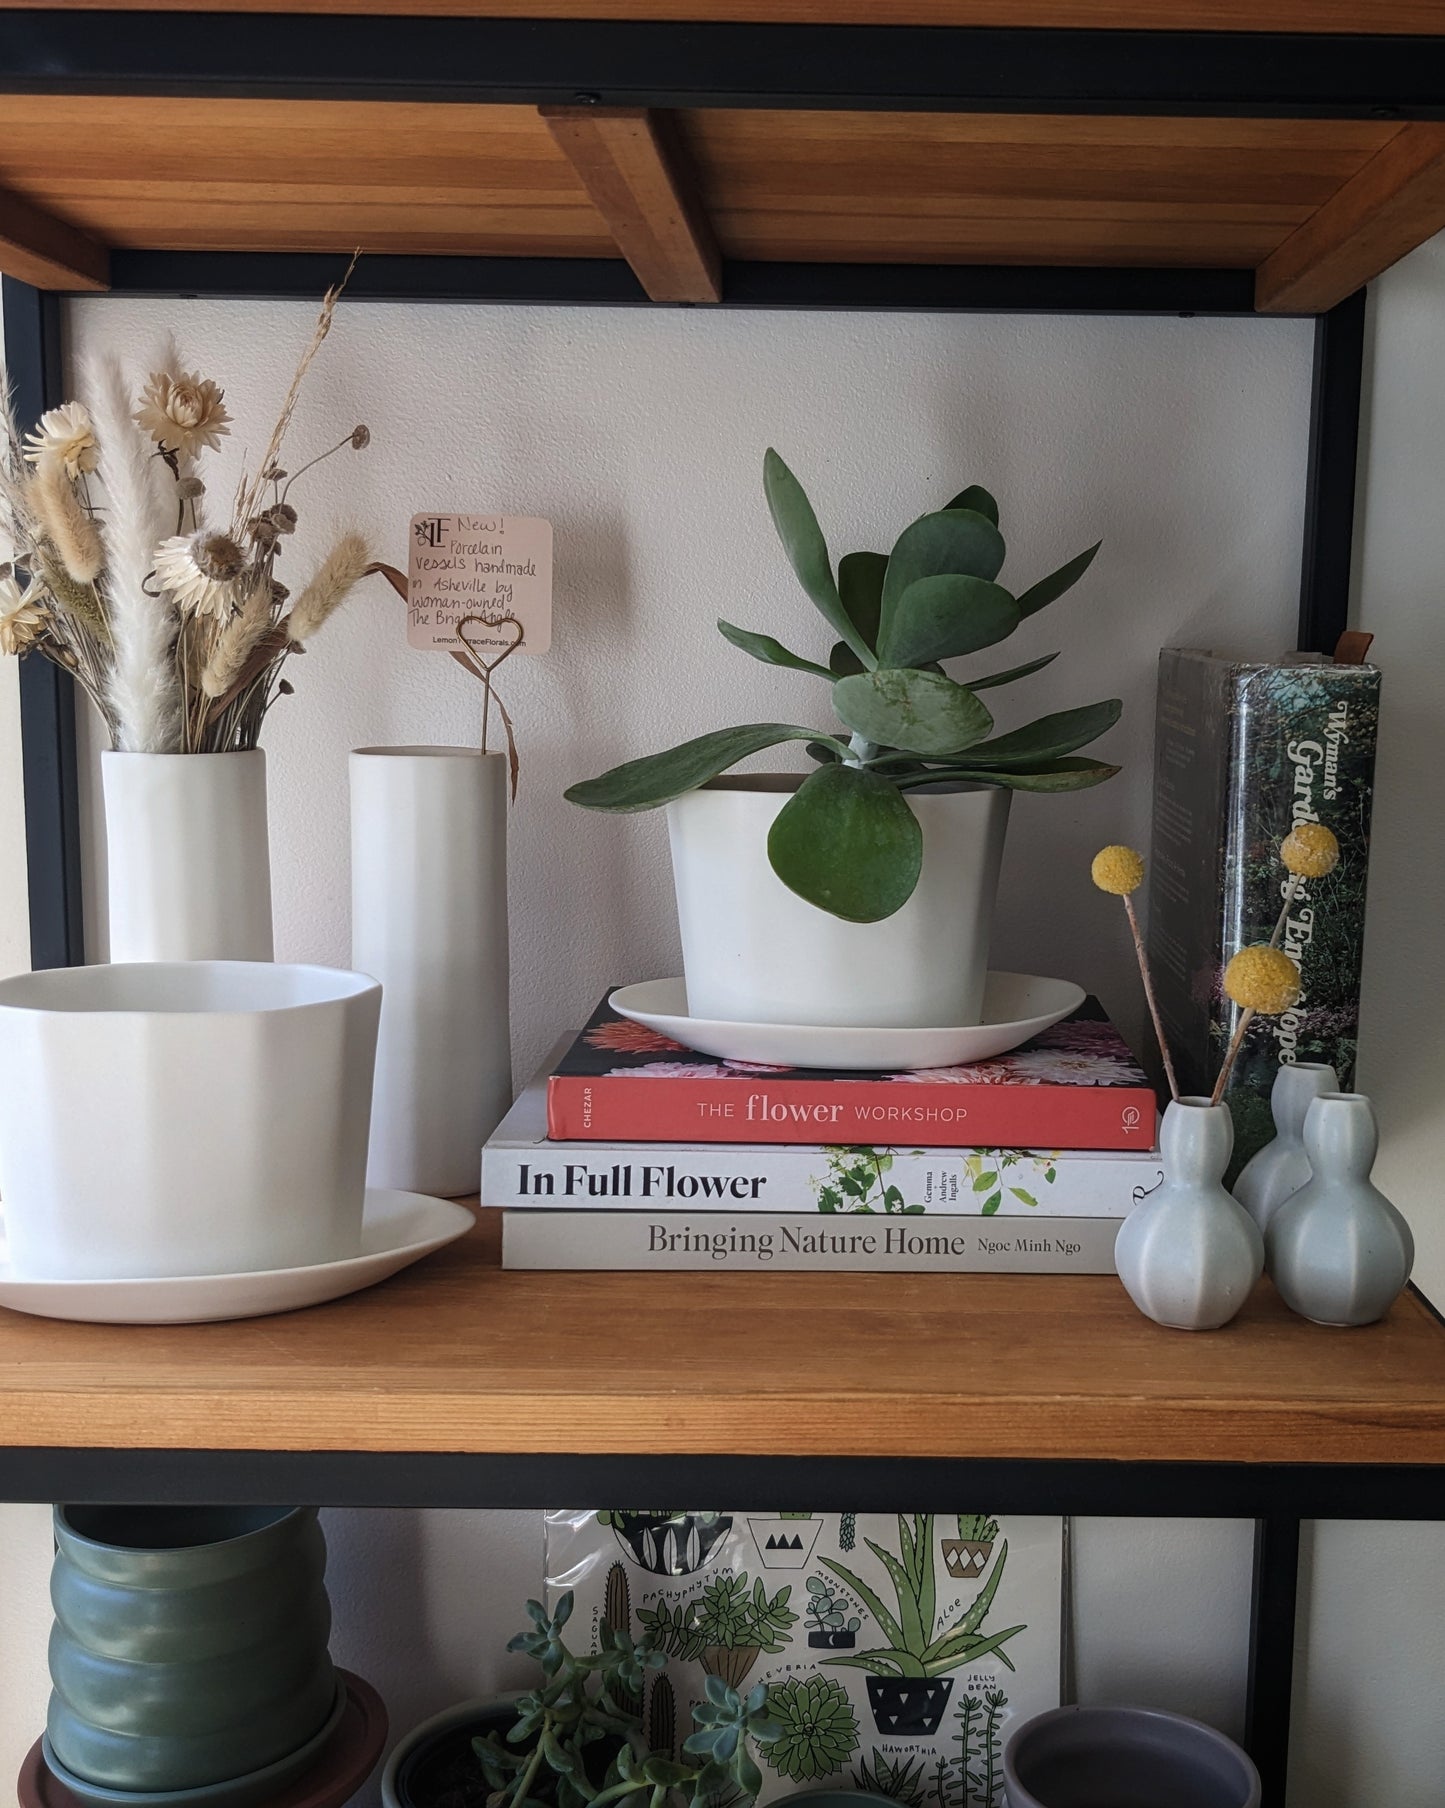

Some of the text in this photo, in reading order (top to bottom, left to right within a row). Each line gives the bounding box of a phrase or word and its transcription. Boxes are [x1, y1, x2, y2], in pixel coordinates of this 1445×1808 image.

[457, 517, 504, 535] New!
[450, 540, 503, 556] Porcelain
[475, 558, 536, 577] handmade
[495, 580, 513, 602] by
[408, 608, 430, 627] The
[1323, 700, 1350, 801] Wyman's
[583, 1087, 593, 1128] CHEZAR
[697, 1095, 968, 1122] THE flower WORKSHOP
[517, 1164, 767, 1199] In Full Flower
[924, 1171, 933, 1203] Gemma
[939, 1171, 948, 1203] Andrew
[949, 1174, 959, 1201] Ingalls
[648, 1224, 1082, 1260] Bringing Nature Home Ngoc Minh Ngo
[643, 1567, 734, 1603] PACHYPHYTUM
[815, 1570, 869, 1621] MOONSTONES
[590, 1606, 598, 1656] SAGUAR
[744, 1664, 816, 1701] EHEVERIA
[967, 1674, 996, 1682] JELLY
[968, 1683, 997, 1691] BEAN
[882, 1744, 937, 1756] HAWORTHIA
